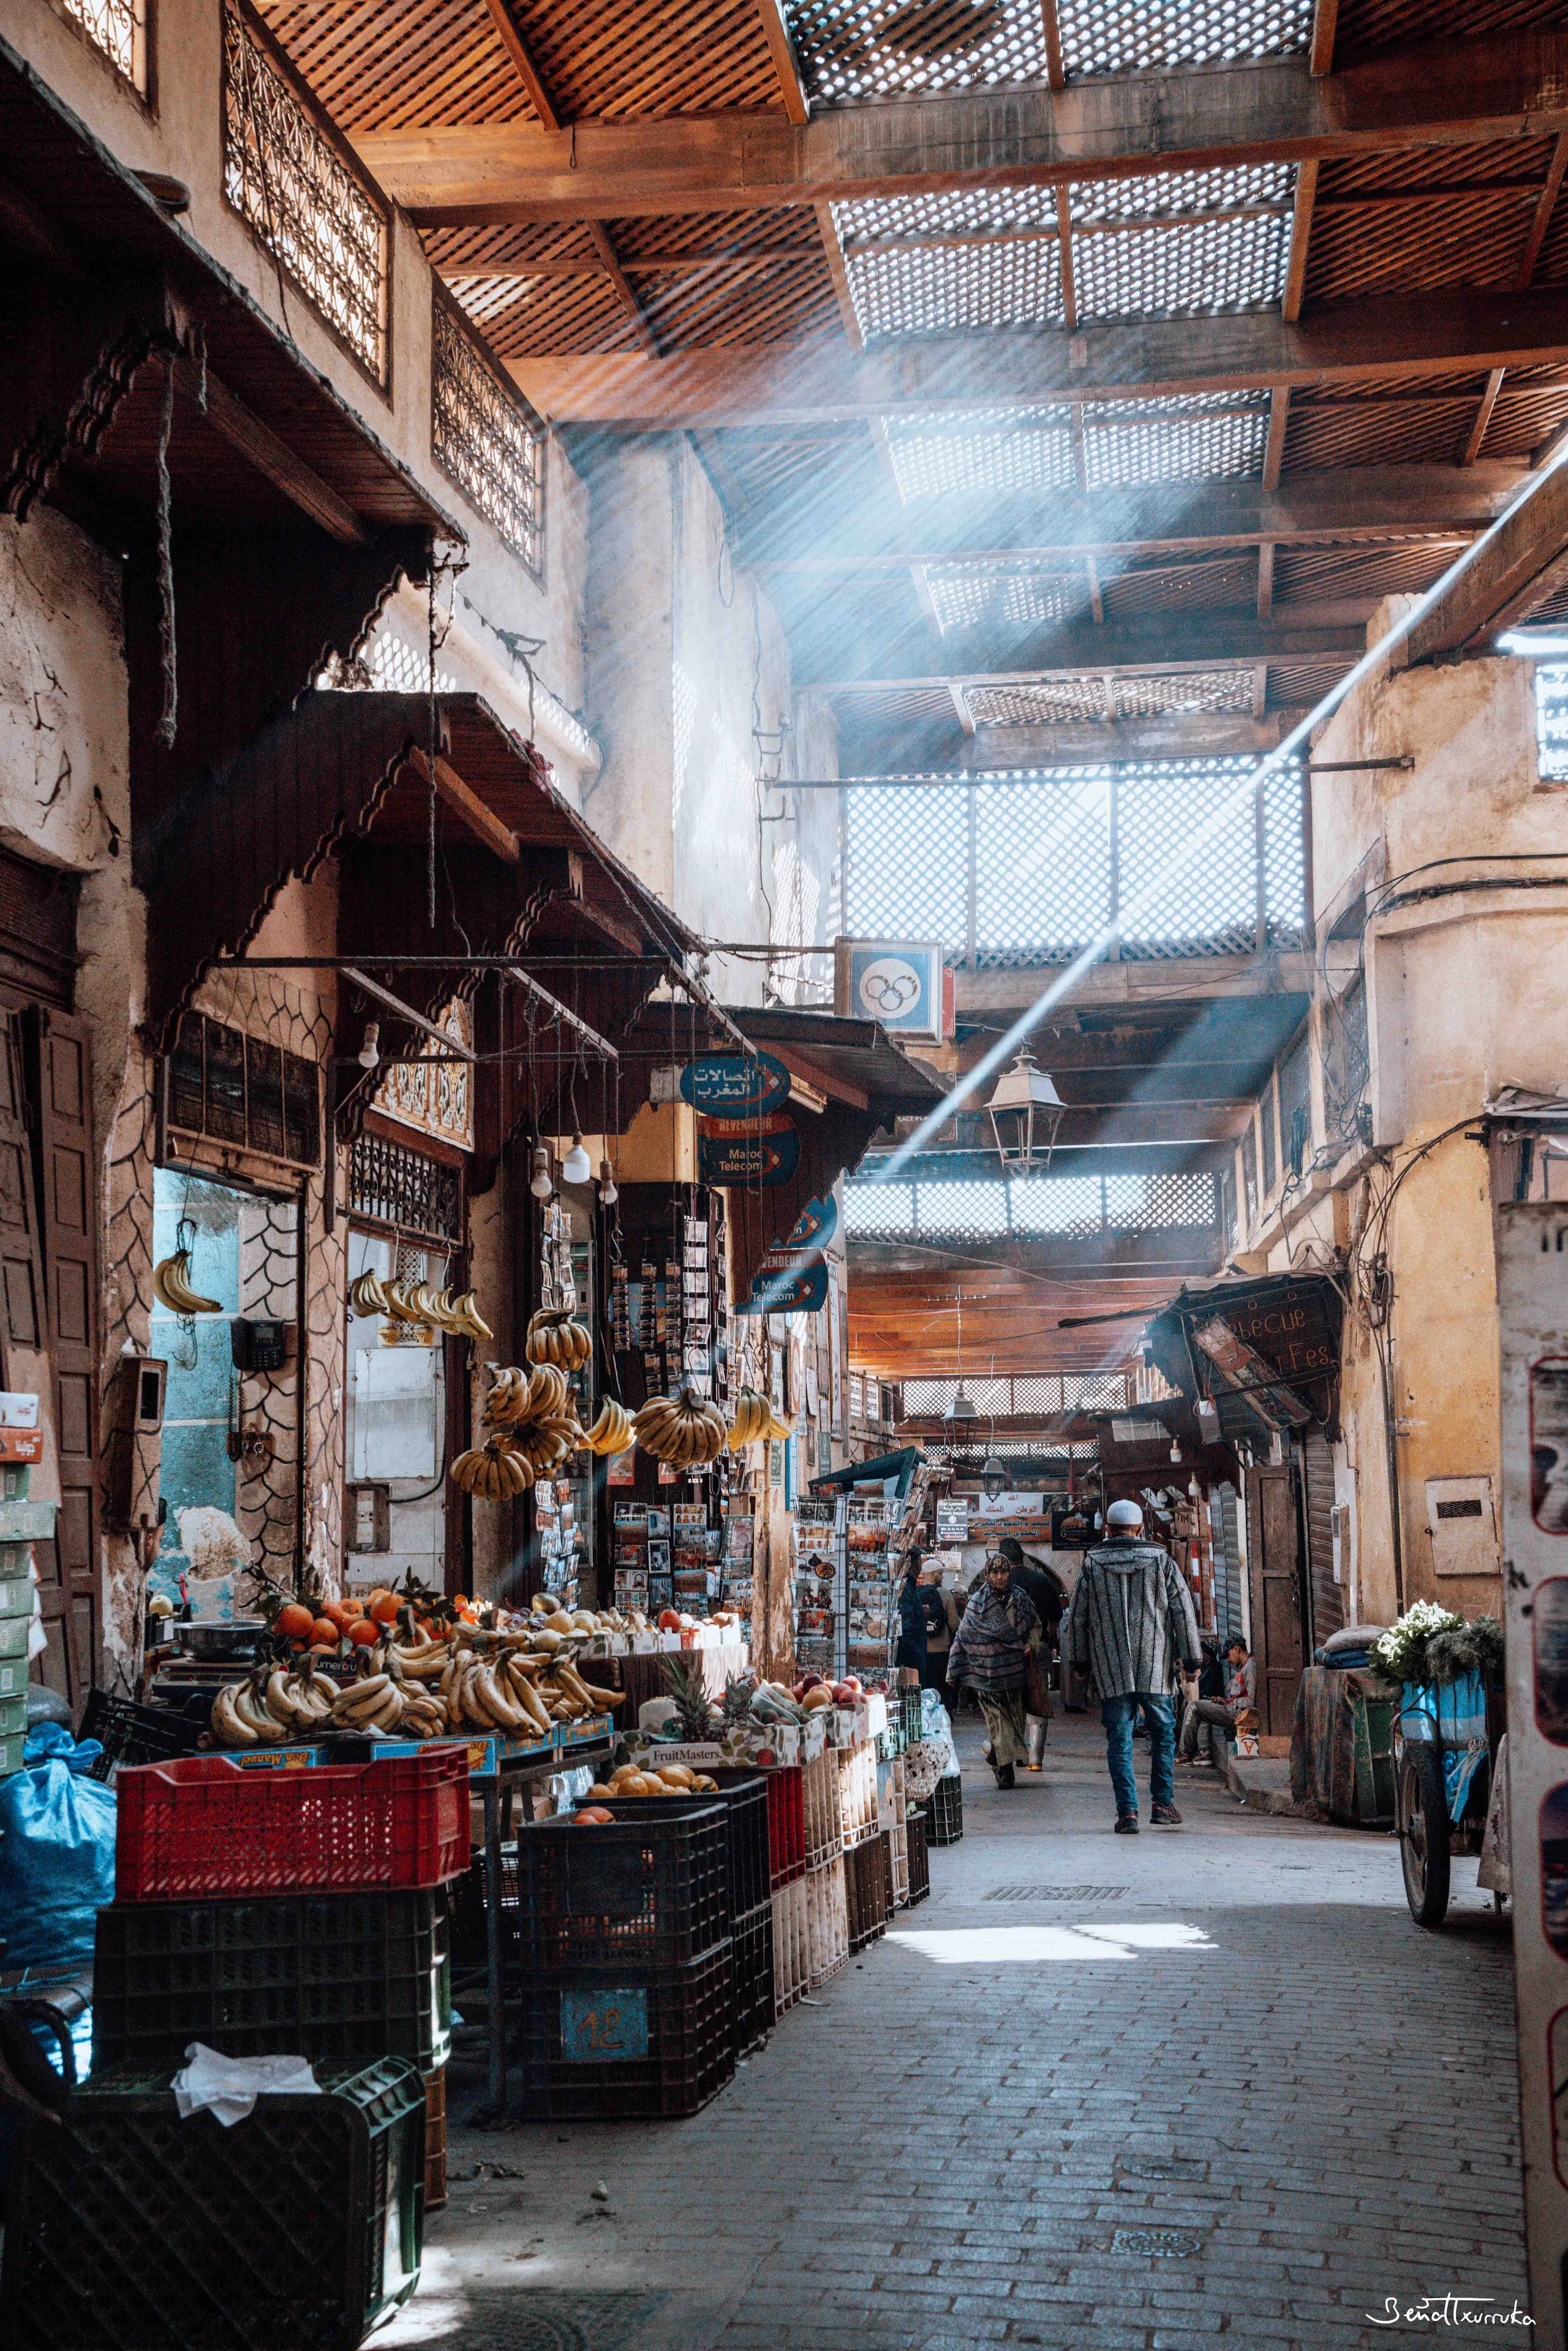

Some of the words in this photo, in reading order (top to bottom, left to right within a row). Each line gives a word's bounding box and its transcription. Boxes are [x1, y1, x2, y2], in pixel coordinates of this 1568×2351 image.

[694, 1069, 755, 1082] اتصالات
[697, 1082, 750, 1098] المغرب
[719, 1117, 772, 1131] REVENDEUR
[729, 1149, 763, 1159] Maroc
[719, 1161, 763, 1171] Telecom
[761, 1281, 794, 1289] Maroc
[752, 1291, 794, 1302] Telecom
[1289, 1342, 1329, 1372] Fes
[1016, 1505, 1037, 1514] الوطن
[315, 1661, 349, 1671] umero
